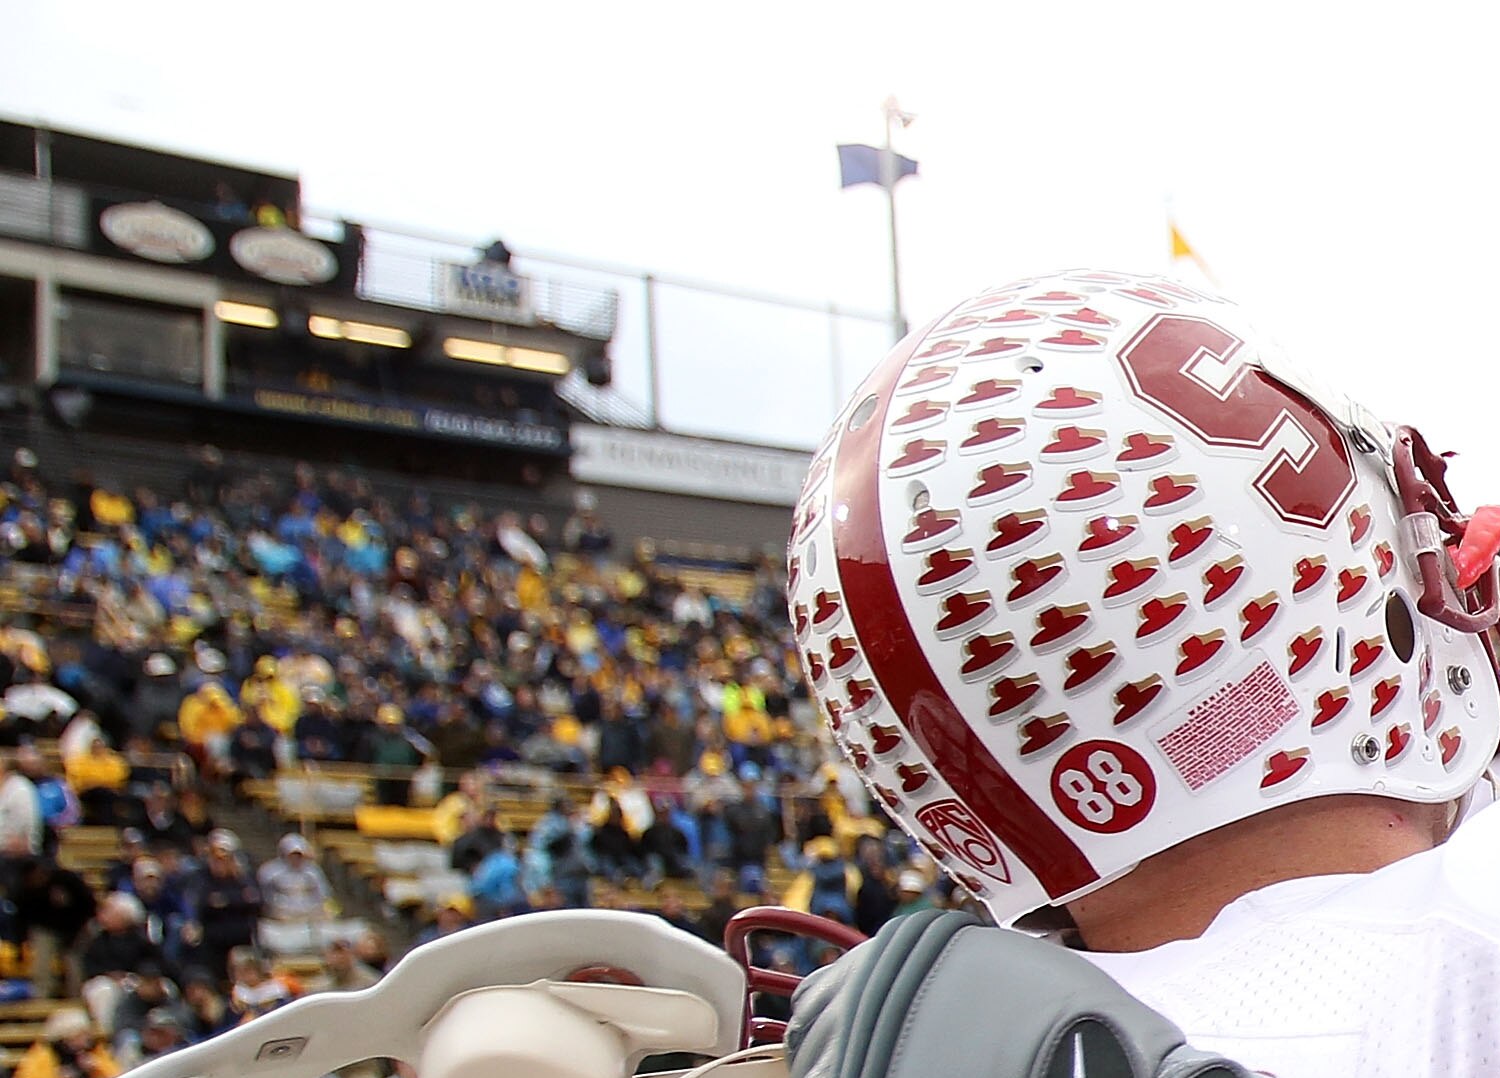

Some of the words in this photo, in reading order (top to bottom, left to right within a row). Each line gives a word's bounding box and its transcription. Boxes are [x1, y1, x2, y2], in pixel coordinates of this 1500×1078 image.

[1116, 313, 1358, 530] S
[1188, 682, 1233, 716] WARNING
[1058, 749, 1143, 825] 88
